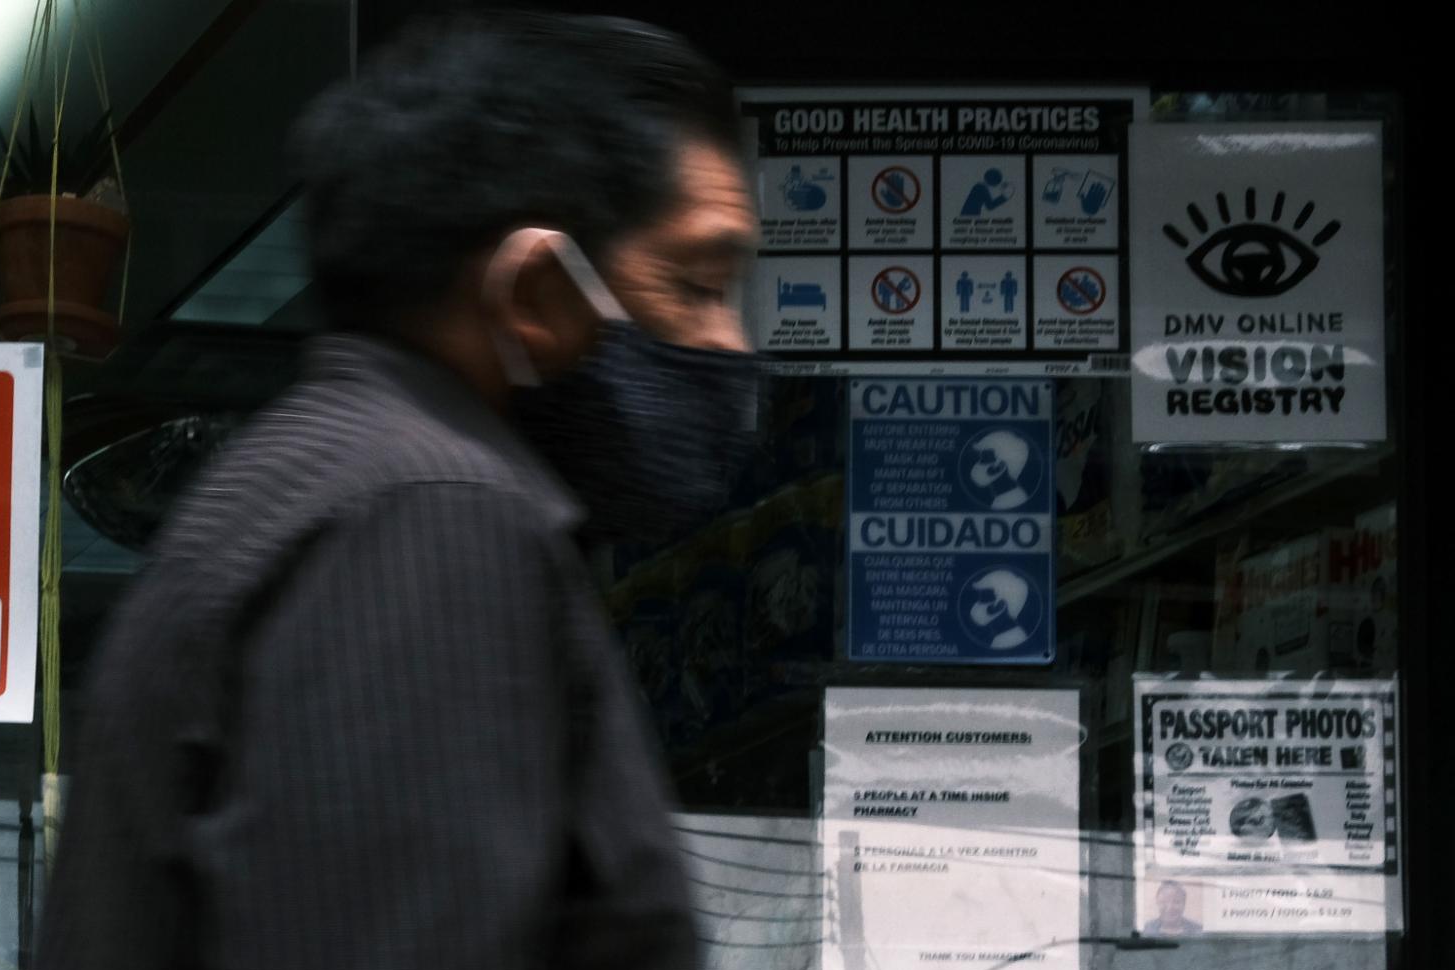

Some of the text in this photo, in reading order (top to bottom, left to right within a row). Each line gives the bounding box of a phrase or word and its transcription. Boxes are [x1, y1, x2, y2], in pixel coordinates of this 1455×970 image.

[774, 105, 1100, 134] GOOD HEALTH PRACTICES
[792, 135, 818, 151] Help
[823, 135, 869, 151] Prevent
[872, 135, 891, 151] the
[895, 135, 938, 151] Spread
[958, 135, 1015, 151] COVID-19
[1018, 135, 1100, 151] (Coronavirus)
[1164, 312, 1344, 337] DMV ONLINE
[1165, 345, 1345, 385] VISION
[862, 384, 1039, 417] CAUTION
[1166, 387, 1346, 416] REGISTRY
[884, 454, 938, 465] MASK AND
[887, 483, 953, 495] SEPARATION
[874, 498, 947, 509] FROM OTHERS
[860, 516, 1041, 549] CUIDADO
[871, 600, 931, 612] MANTENGA
[879, 614, 938, 627] INTERVALO
[862, 644, 958, 656] DE OTRA PERSONA
[1160, 707, 1376, 740] PASSPORT PHOTOS
[865, 731, 1032, 744] ATTENTION CUSTOMERS:
[1199, 745, 1333, 767] TAKEN HERE
[863, 791, 909, 803] PEOPLE
[911, 791, 926, 803] AT
[928, 791, 937, 803] A
[941, 791, 969, 803] TIME
[853, 806, 918, 818] PHARMACY
[872, 862, 887, 873] LA
